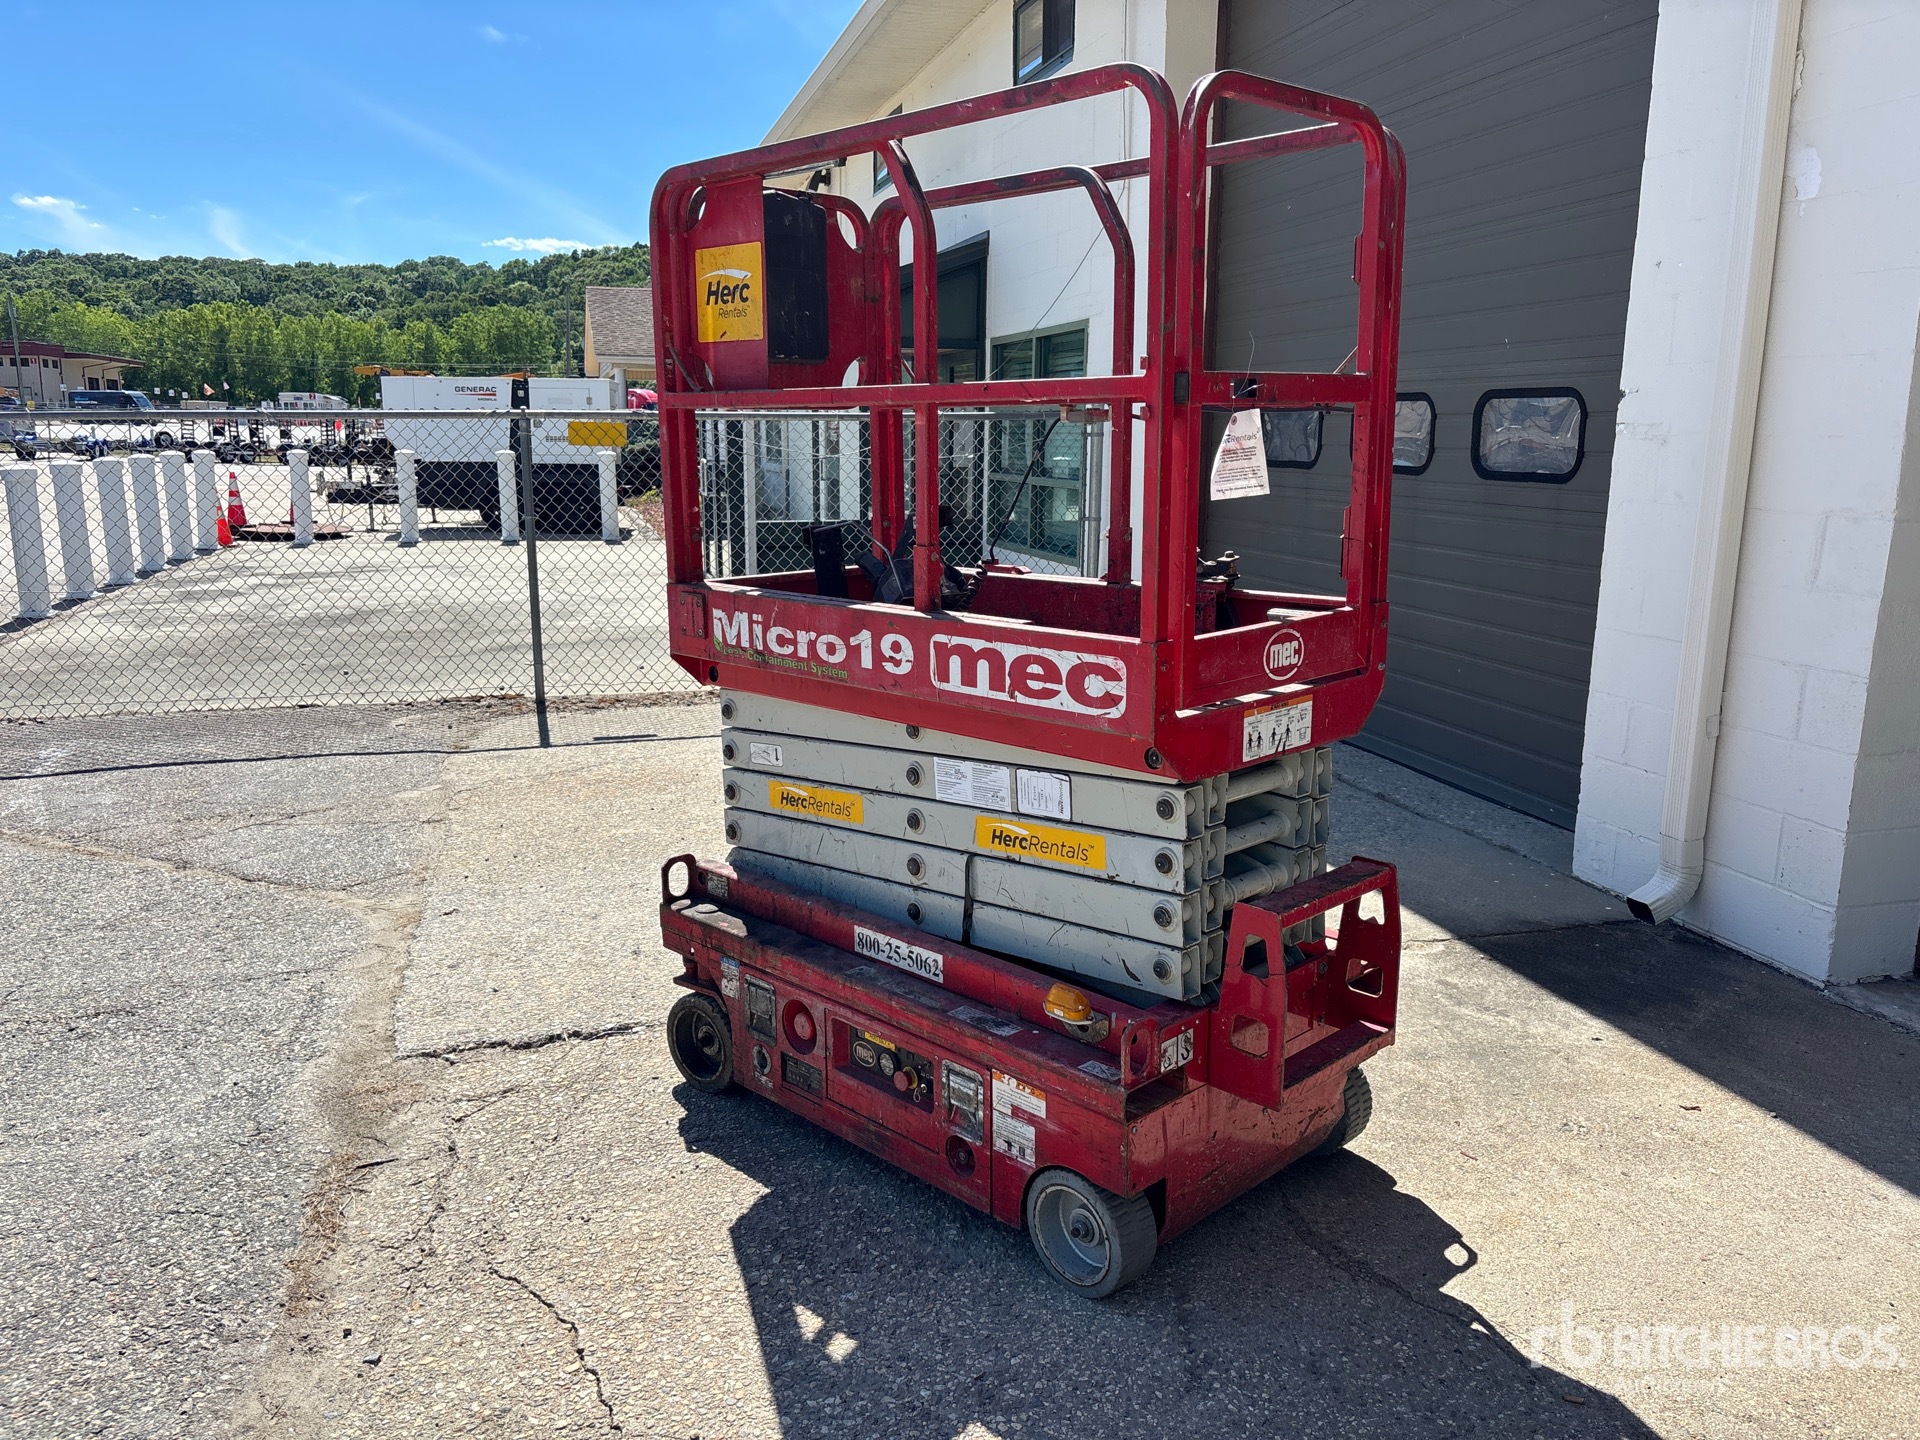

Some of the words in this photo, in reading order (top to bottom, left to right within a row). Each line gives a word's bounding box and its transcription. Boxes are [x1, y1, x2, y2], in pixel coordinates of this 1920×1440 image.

[706, 281, 750, 306] Herc
[718, 306, 748, 319] Rentals
[1269, 640, 1299, 669] mec
[811, 660, 848, 679] System
[932, 640, 1125, 710] mec
[780, 791, 851, 817] HercRentals
[991, 829, 1088, 862] HercRentals
[857, 931, 940, 978] 800-25-5062
